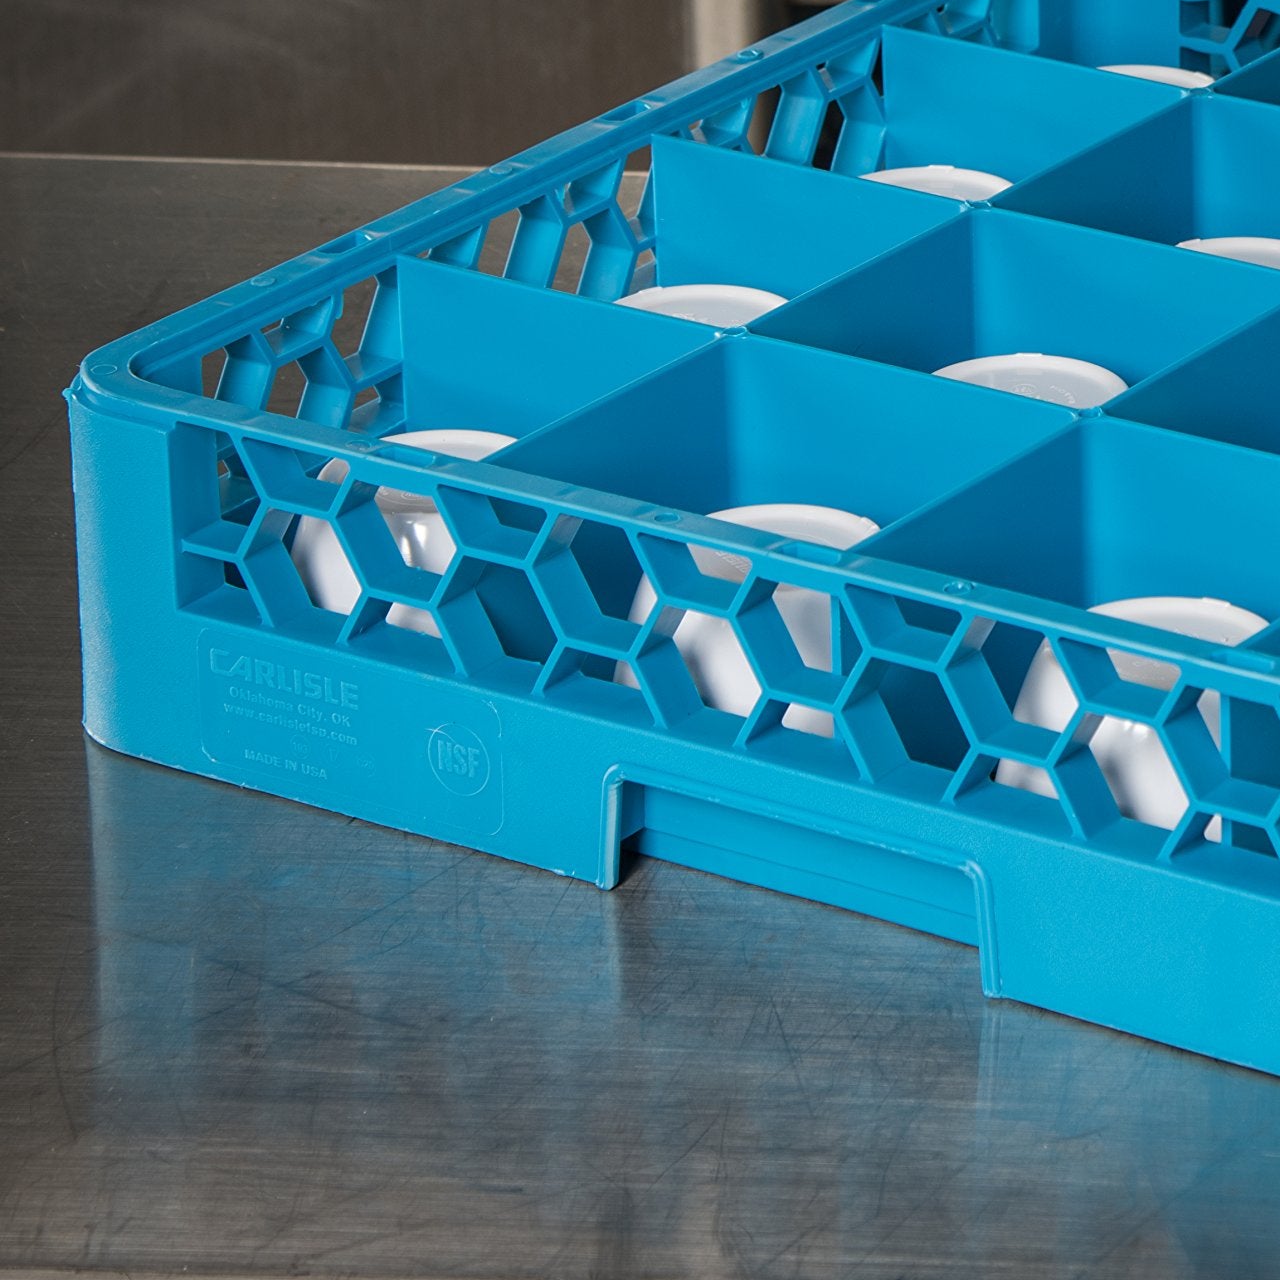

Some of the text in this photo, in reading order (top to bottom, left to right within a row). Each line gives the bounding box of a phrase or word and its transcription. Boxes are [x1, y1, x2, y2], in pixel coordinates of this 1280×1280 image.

[209, 647, 358, 710] CARLISLE
[223, 703, 358, 746] www.carlislefsp.com
[229, 686, 293, 712] Oklahoma
[331, 712, 351, 728] OK
[244, 748, 328, 780] MADE IN USA
[437, 739, 480, 778] NSF
